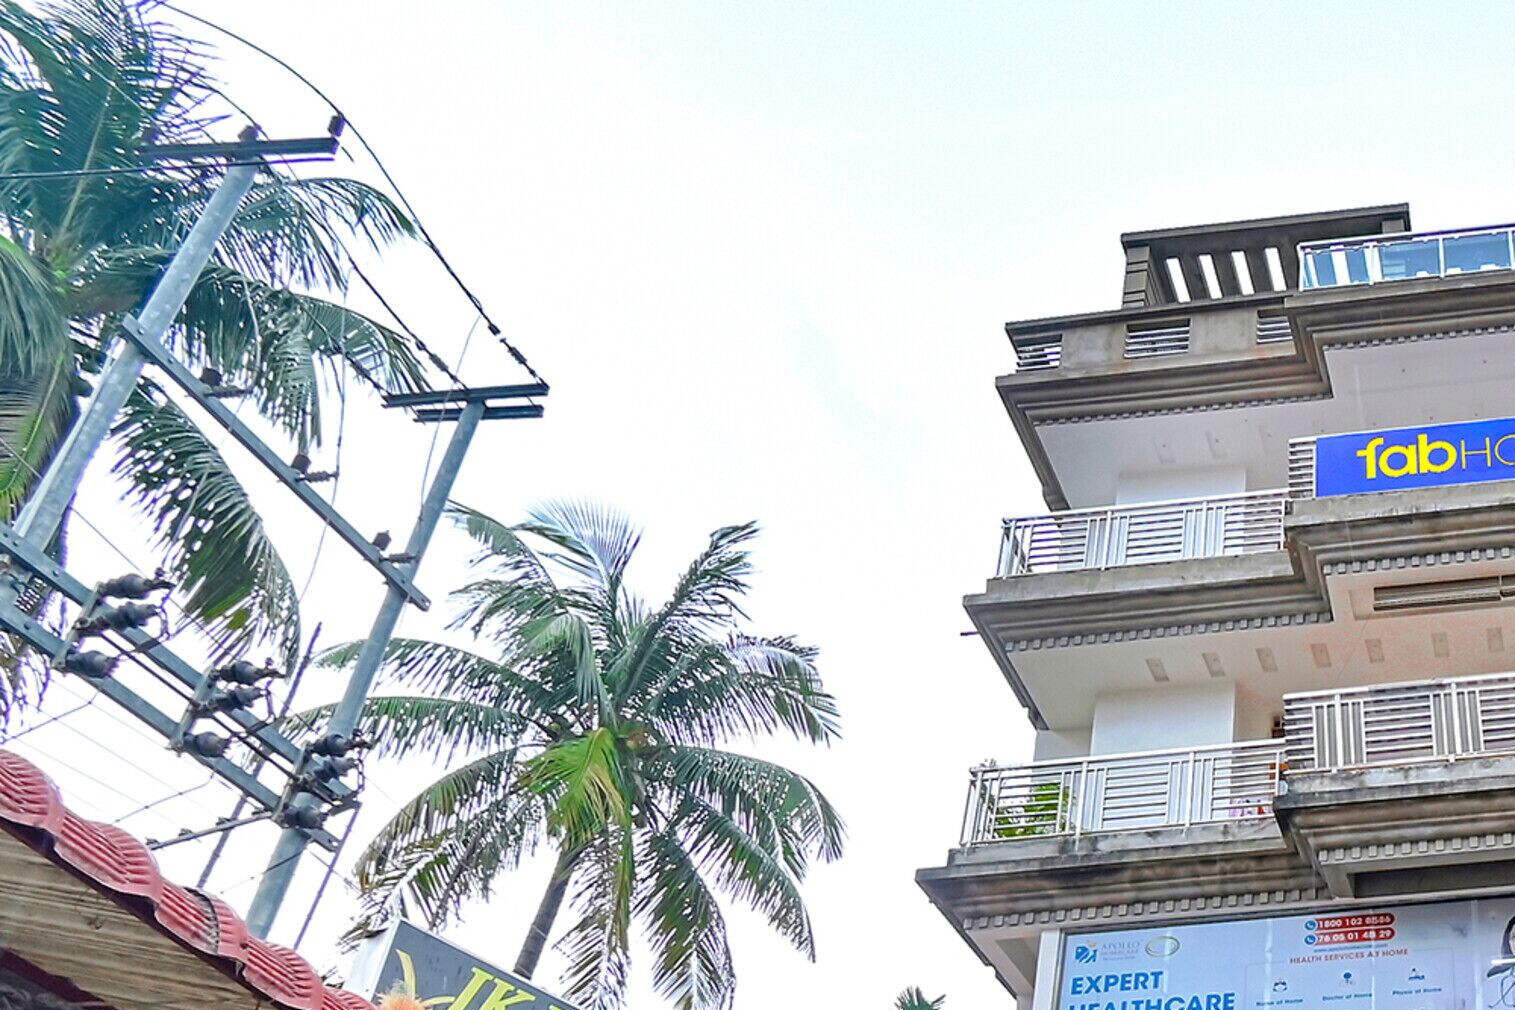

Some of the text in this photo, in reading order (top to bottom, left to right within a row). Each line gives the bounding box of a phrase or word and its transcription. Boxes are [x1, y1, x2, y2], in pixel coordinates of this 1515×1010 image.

[1318, 918, 1342, 929] 1800
[1345, 916, 1363, 927] 102
[1289, 948, 1409, 965] HEALTH SERVICES AT HOME
[1070, 970, 1164, 996] EXPERT
